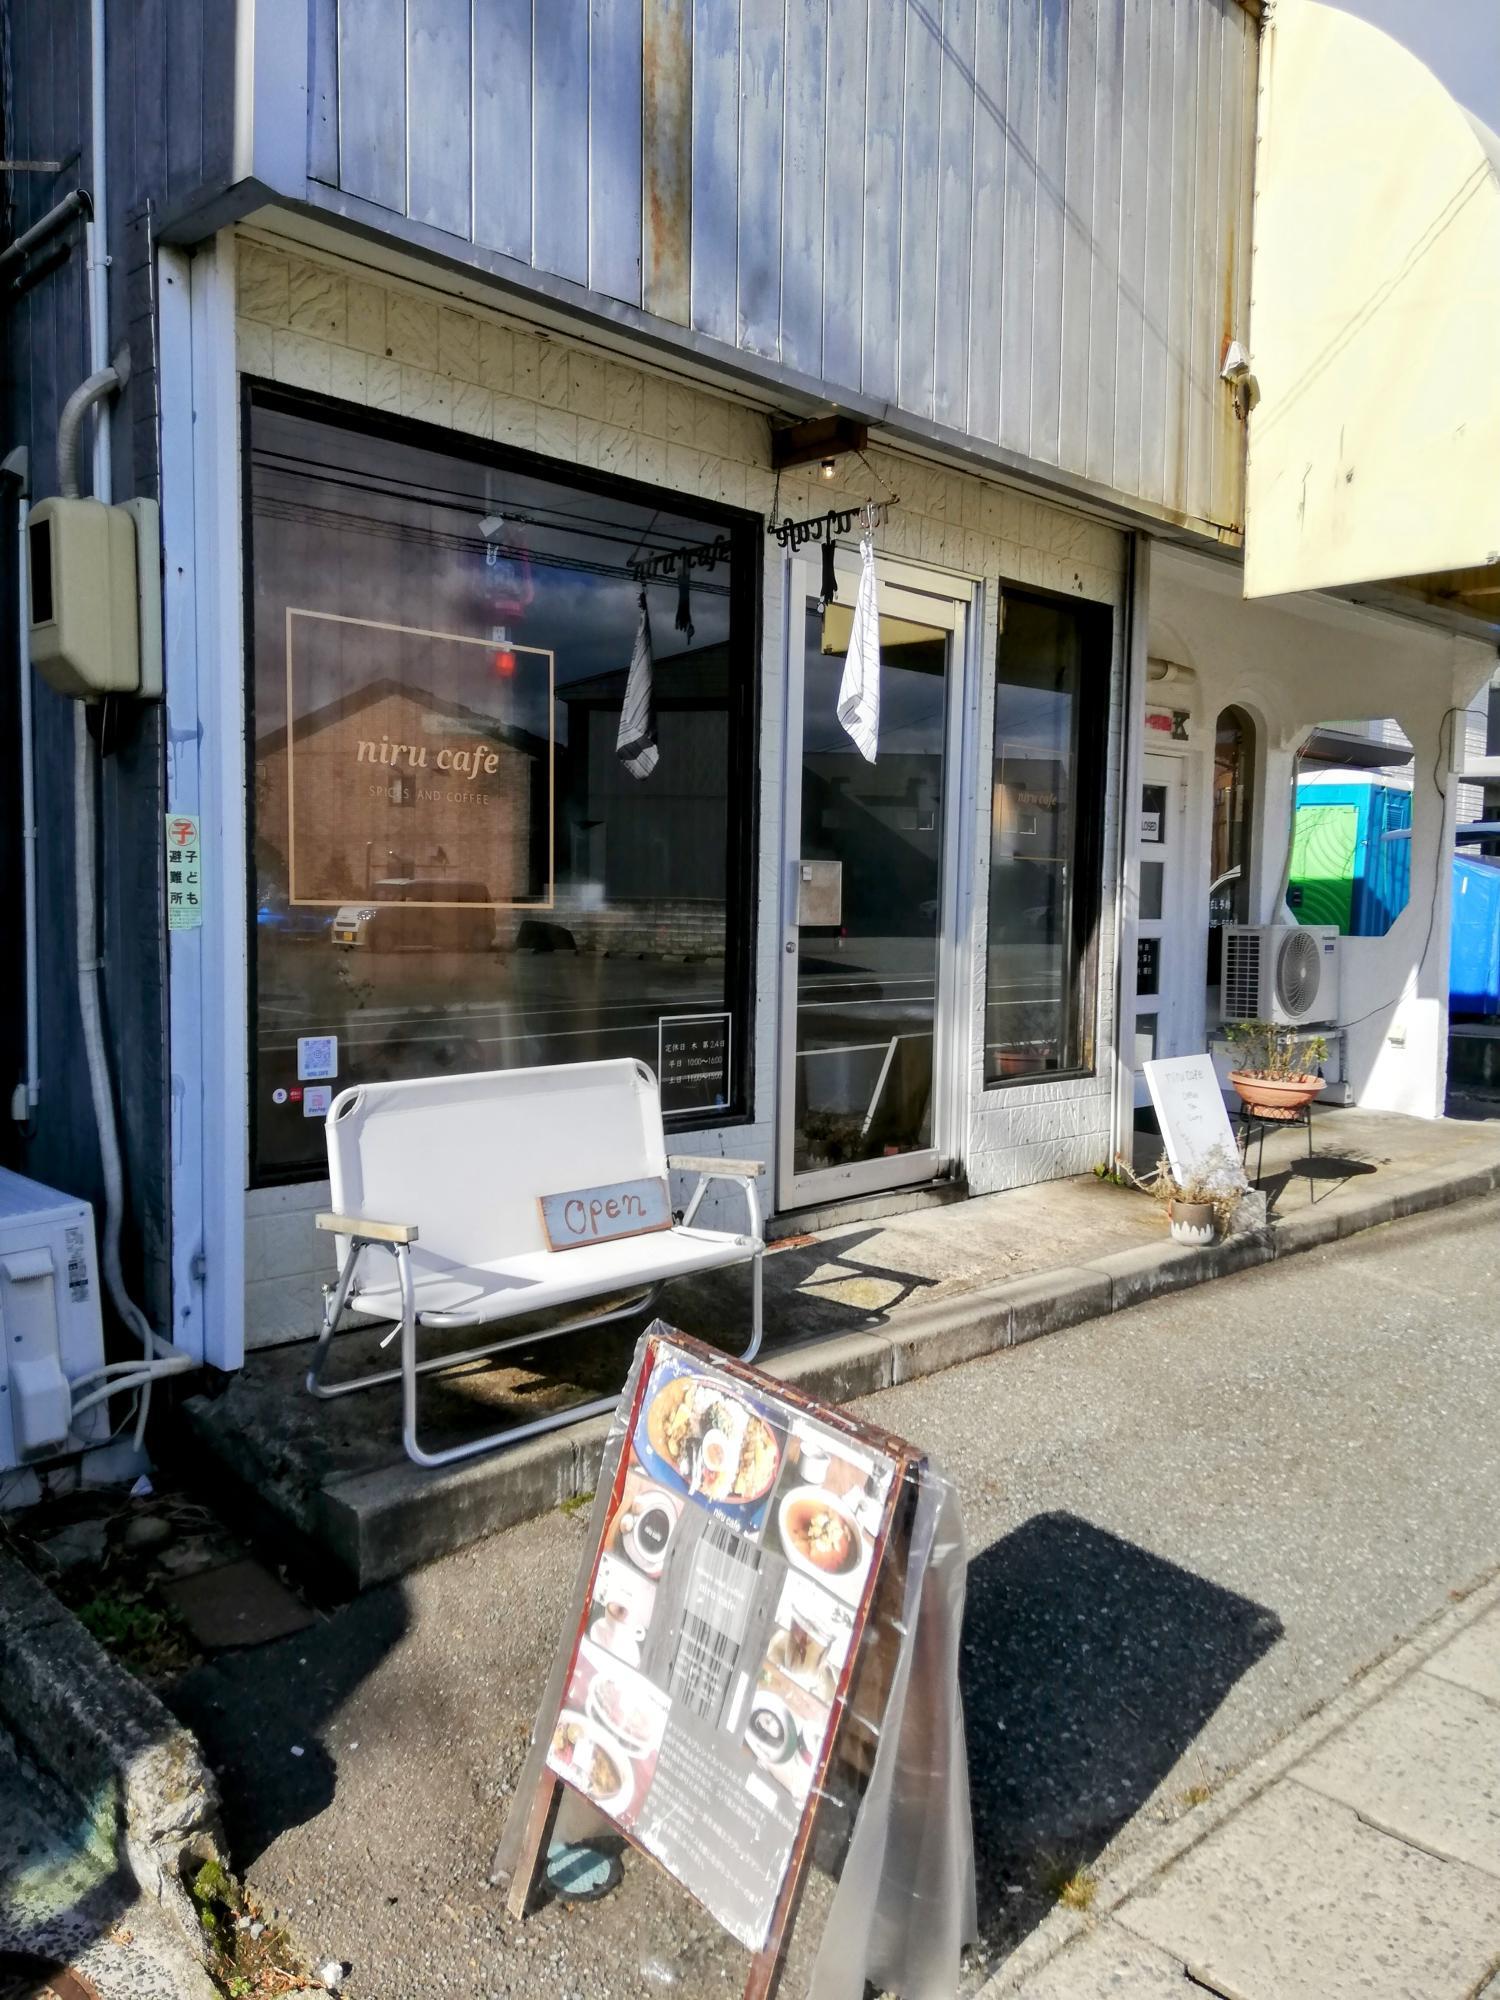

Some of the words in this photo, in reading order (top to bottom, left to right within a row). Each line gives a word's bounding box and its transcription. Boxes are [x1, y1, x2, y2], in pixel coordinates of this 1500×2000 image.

[356, 735, 428, 768] niru
[436, 744, 499, 780] cafe
[369, 785, 409, 799] SPICS
[417, 789, 441, 801] AND
[447, 791, 490, 805] COFFEE
[172, 823, 194, 844] 子
[1141, 821, 1157, 831] LOSED
[169, 850, 184, 905] 避難所
[185, 851, 199, 905] 子ども
[564, 1193, 647, 1235] Open
